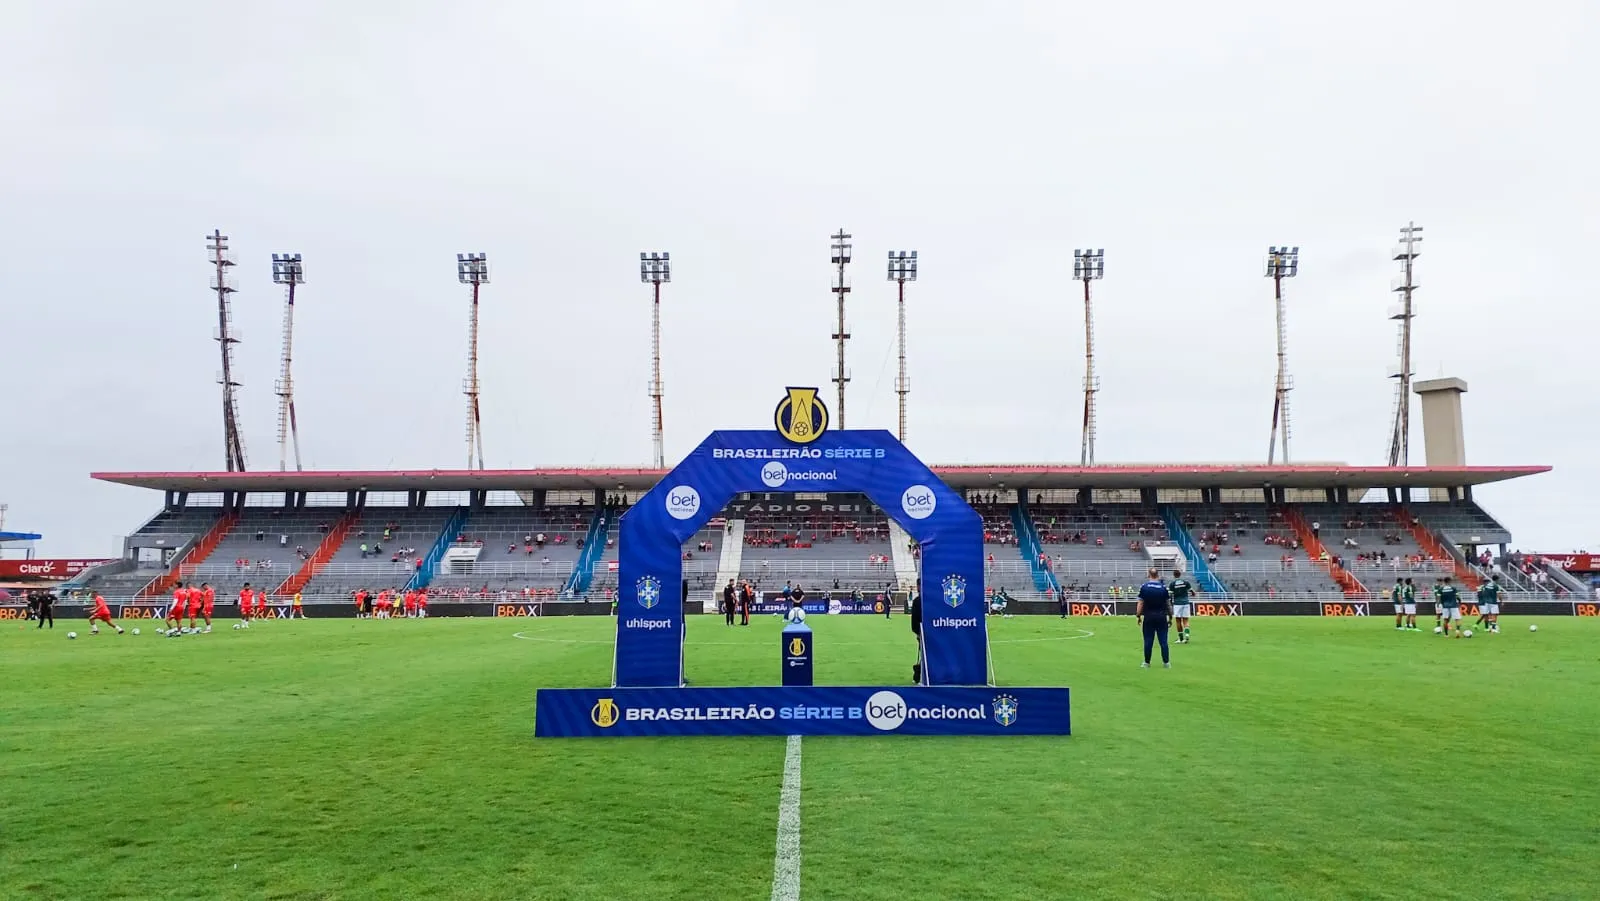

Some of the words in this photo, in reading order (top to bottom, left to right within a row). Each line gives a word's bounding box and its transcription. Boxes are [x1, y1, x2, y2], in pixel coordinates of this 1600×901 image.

[713, 446, 822, 459] BRASILEIRÃO
[824, 446, 872, 459] SÉRIE
[874, 448, 886, 459] B
[763, 468, 786, 480] bet
[787, 469, 837, 480] nacional
[671, 492, 696, 507] bet
[906, 492, 932, 506] bet
[821, 504, 860, 512] REI
[20, 563, 51, 573] Claro
[0, 608, 28, 620] BRA
[123, 607, 165, 619] BRAX
[497, 605, 538, 617] BRAX
[1071, 603, 1112, 616] BRAX
[1196, 603, 1237, 616] BRAX
[1324, 604, 1364, 616] BRAX
[1459, 604, 1480, 616] RA
[626, 618, 671, 630] uhlsport
[932, 617, 977, 629] uhlsport
[625, 704, 775, 721] BRASILEIRÃO
[779, 704, 844, 720] SÉRIE
[848, 707, 863, 720] B
[869, 701, 904, 719] bet
[907, 704, 987, 720] nacional
